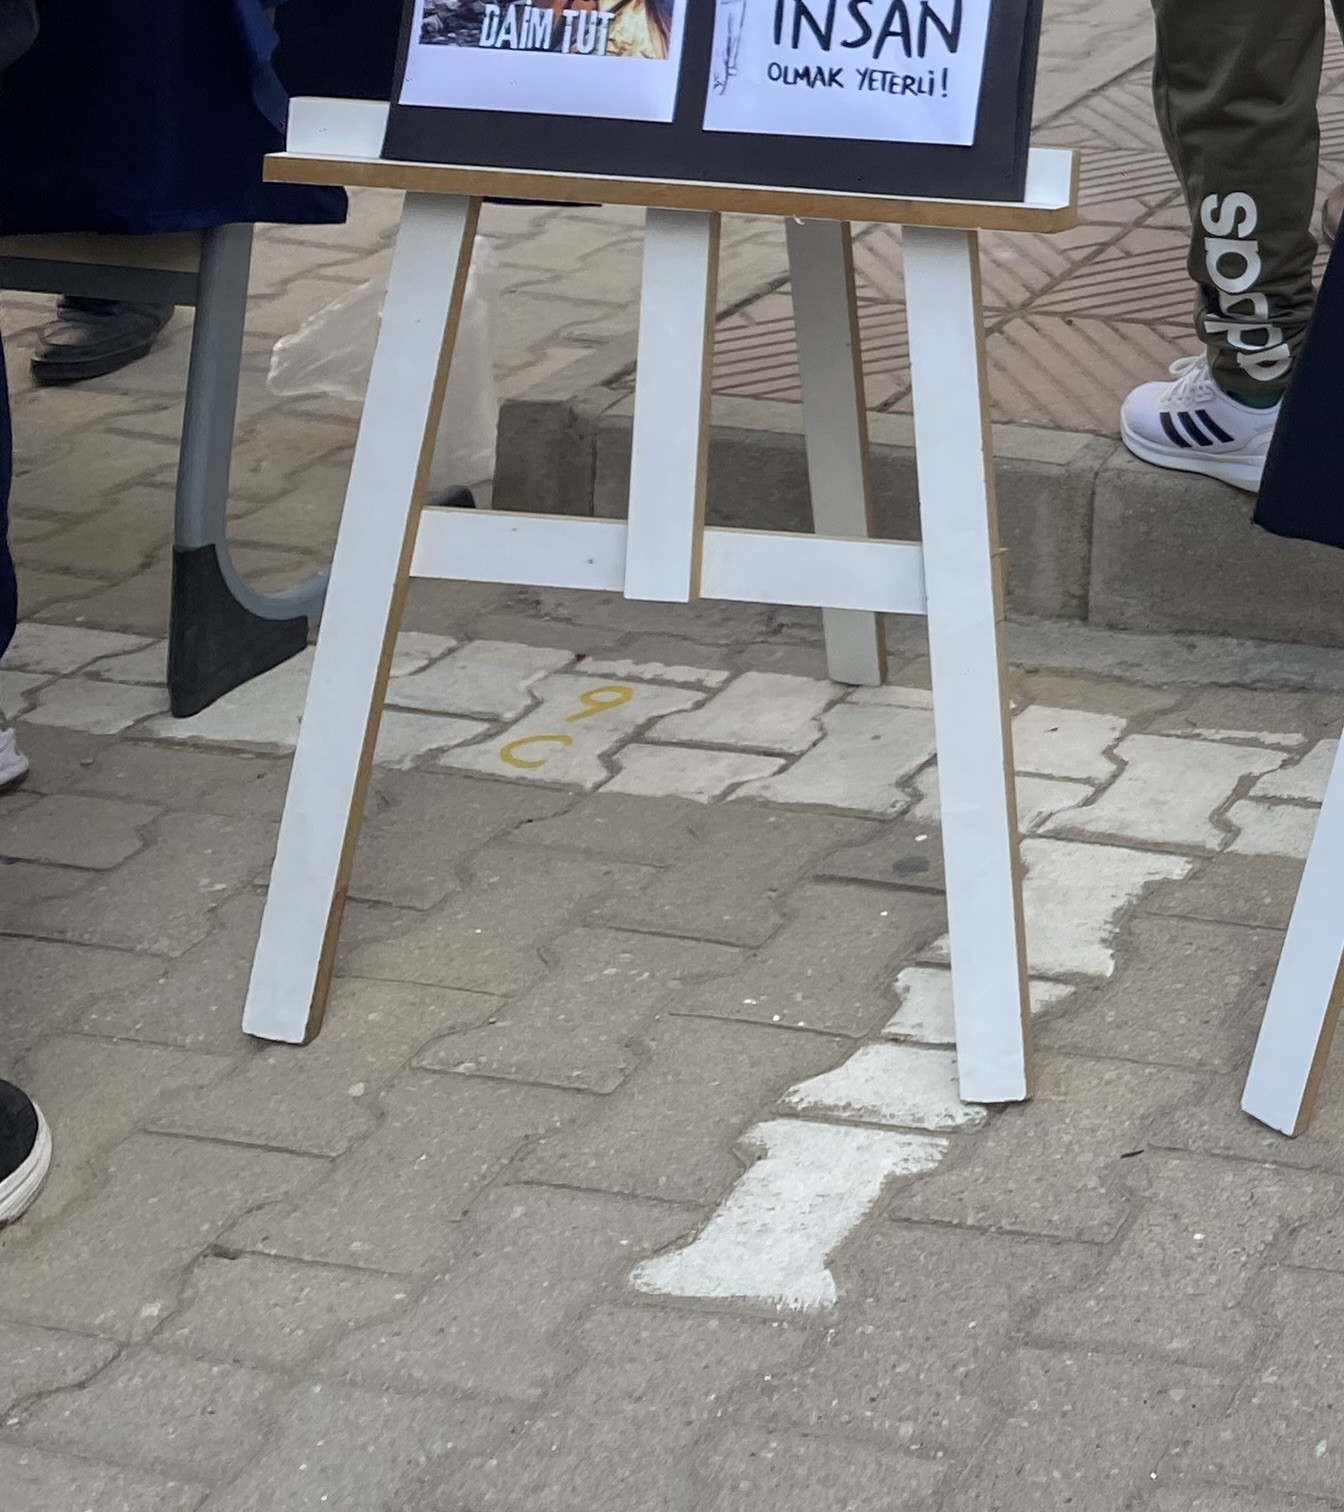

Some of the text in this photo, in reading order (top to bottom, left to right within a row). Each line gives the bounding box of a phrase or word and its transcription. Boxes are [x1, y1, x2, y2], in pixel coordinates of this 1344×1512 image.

[478, 0, 616, 56] DAİM TUT
[767, 61, 844, 89] OLMAK
[564, 685, 634, 724] 9
[499, 734, 574, 769] C
